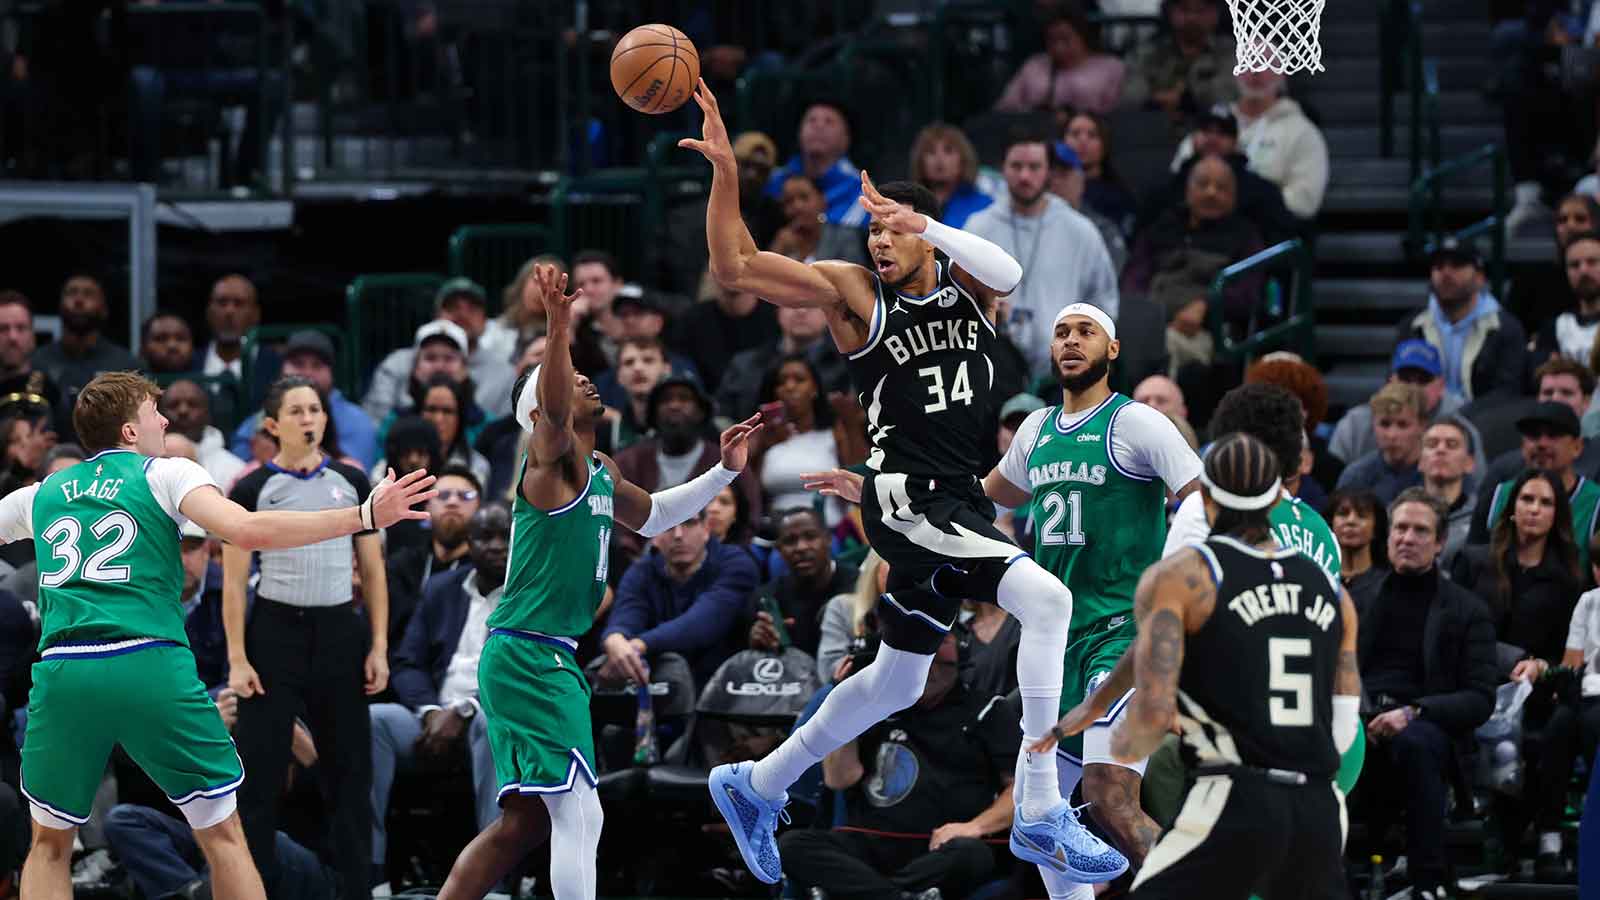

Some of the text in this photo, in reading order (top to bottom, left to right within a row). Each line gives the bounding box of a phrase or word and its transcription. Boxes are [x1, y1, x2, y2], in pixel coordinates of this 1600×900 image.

[884, 319, 979, 366] BUCKS
[918, 360, 974, 413] 34
[1076, 433, 1101, 443] chime
[60, 479, 124, 503] FLAGG
[1028, 461, 1107, 488] DALLAS
[1041, 490, 1086, 545] 21
[40, 510, 138, 587] 32
[1228, 583, 1336, 632] TRENT JR
[726, 681, 801, 696] LEXUS
[1268, 637, 1313, 726] 5
